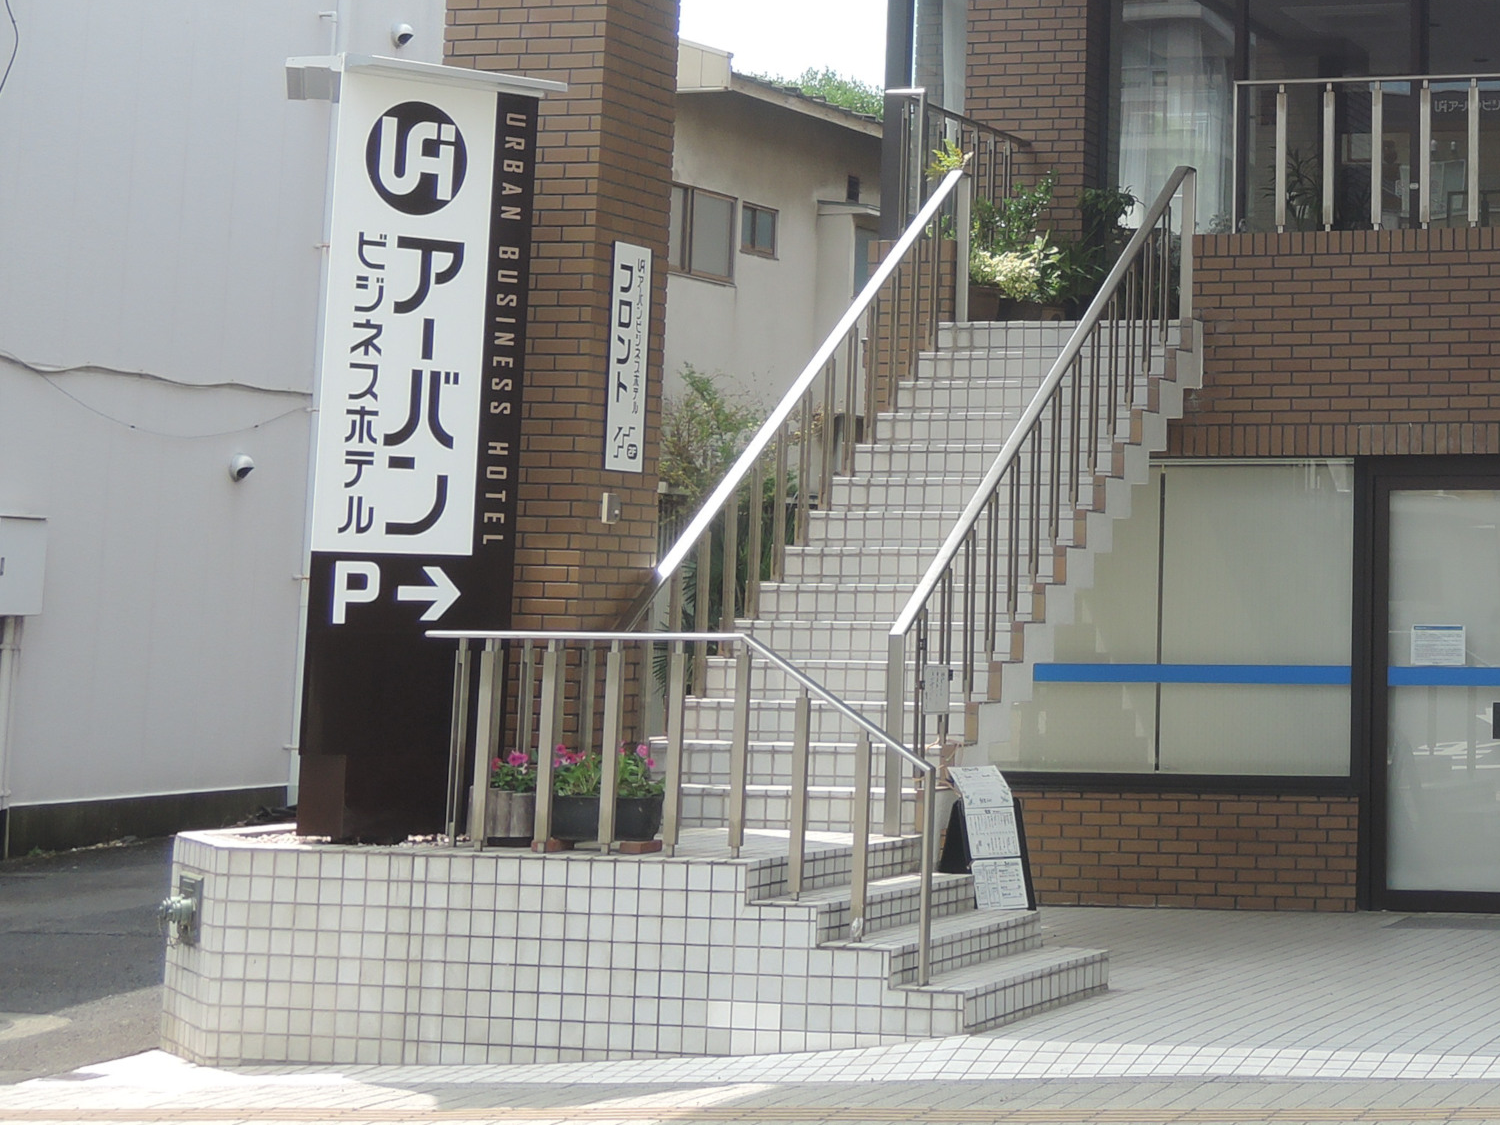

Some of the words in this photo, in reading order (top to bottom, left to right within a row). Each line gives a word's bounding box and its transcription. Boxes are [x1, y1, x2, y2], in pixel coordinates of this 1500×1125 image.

[500, 112, 527, 221] URBAN
[337, 231, 387, 535] ビジネスホテル
[383, 235, 465, 536] アーバン
[489, 246, 520, 416] BUSINESS
[615, 263, 634, 404] フロント
[482, 441, 510, 545] HOTEL
[332, 560, 381, 625] P
